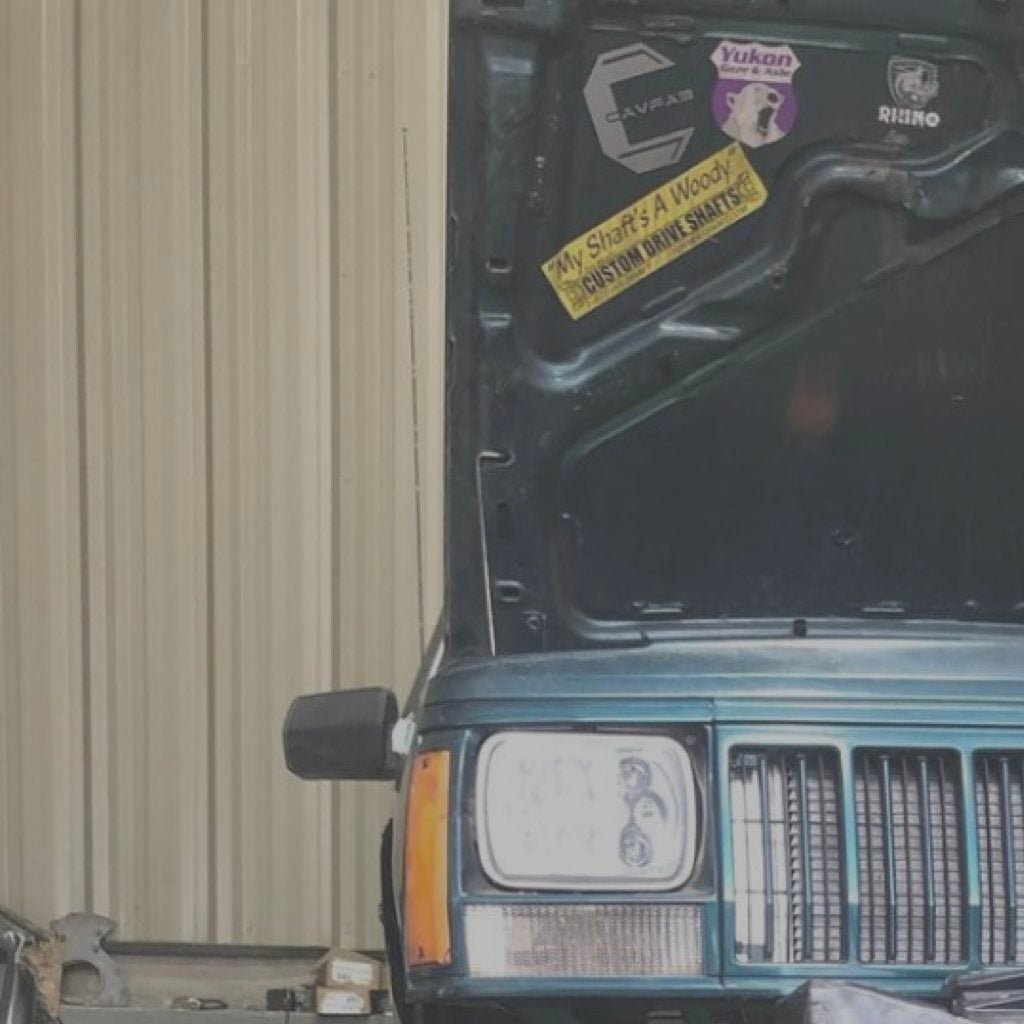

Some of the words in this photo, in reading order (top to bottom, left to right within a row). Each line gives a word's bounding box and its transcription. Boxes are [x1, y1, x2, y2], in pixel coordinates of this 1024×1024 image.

[721, 45, 792, 67] Yukon
[583, 247, 645, 295] CUSTOM
[643, 219, 688, 257] DRIVE
[685, 186, 742, 231] SHAFTS
[586, 207, 650, 259] Shaft's
[654, 193, 669, 219] A
